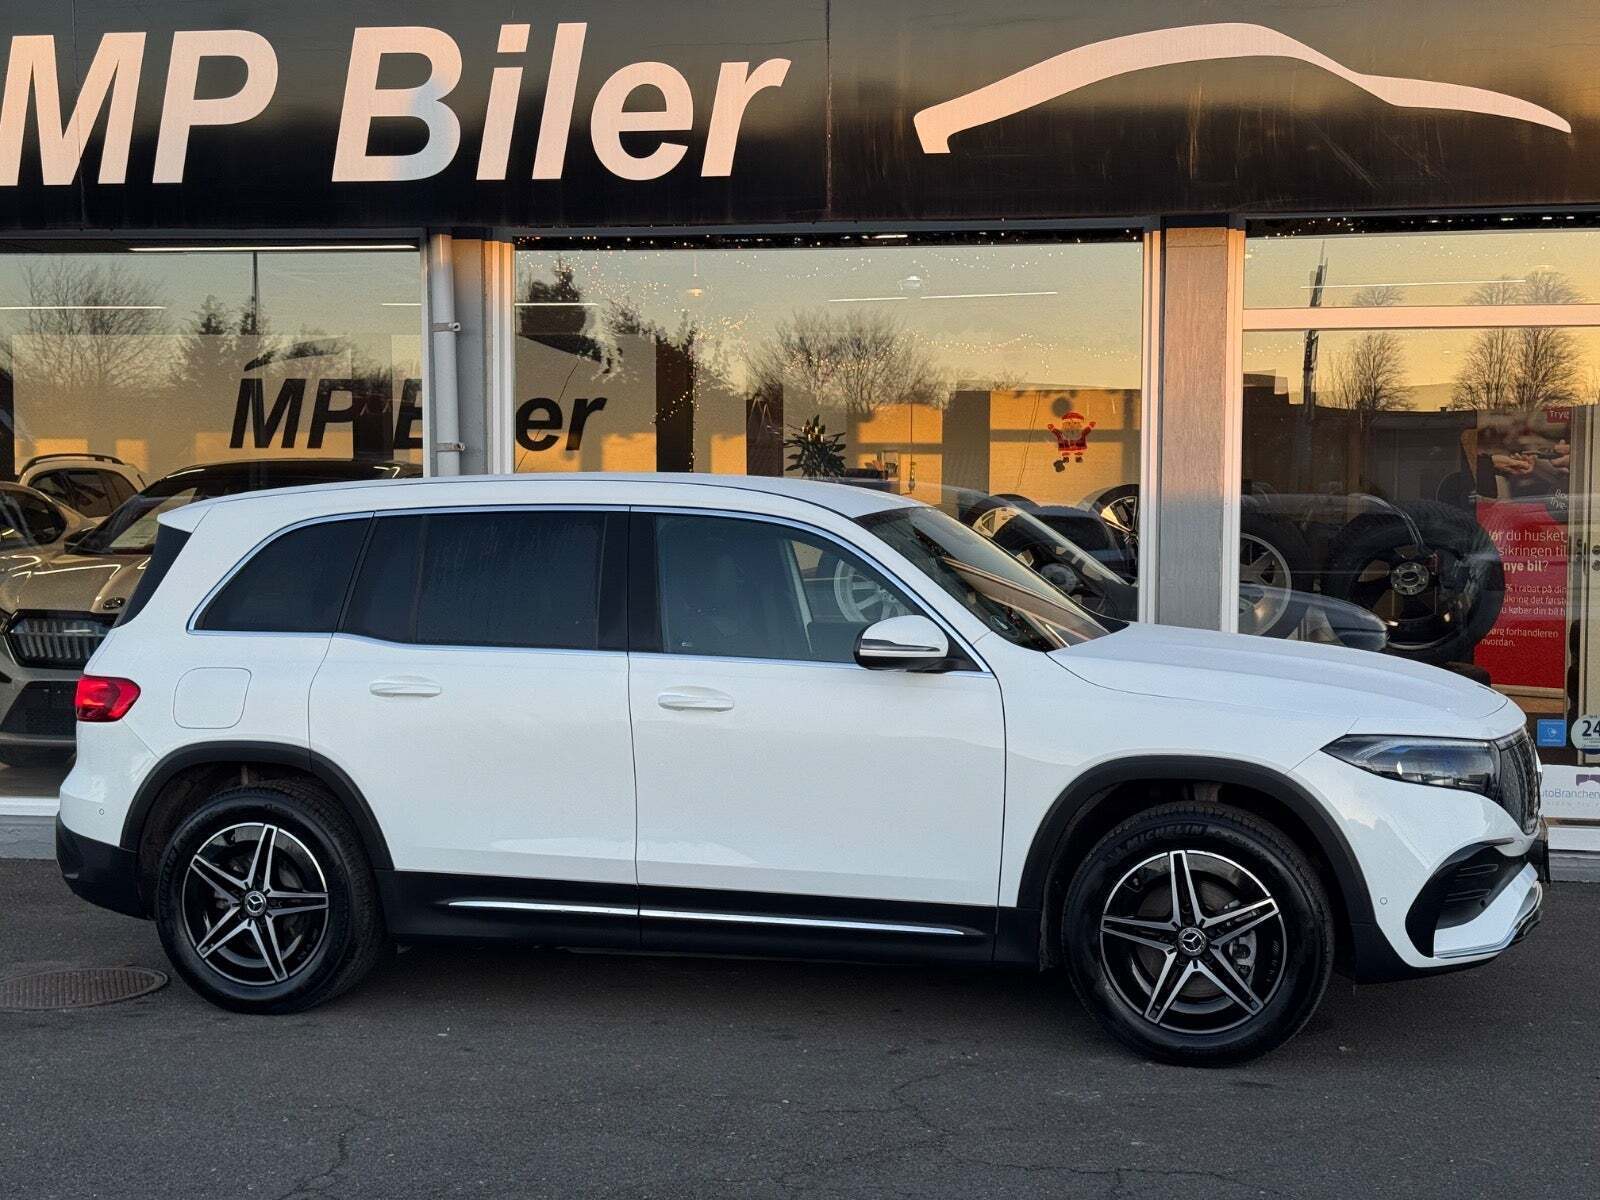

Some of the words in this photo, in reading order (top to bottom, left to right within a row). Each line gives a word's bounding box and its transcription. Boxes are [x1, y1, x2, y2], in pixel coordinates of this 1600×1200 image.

[0, 31, 278, 186] MP
[332, 22, 791, 182] Biler
[229, 378, 358, 450] MP
[1506, 529, 1521, 541] du
[1499, 544, 1553, 559] sikringen
[1503, 561, 1525, 574] nye
[1527, 560, 1549, 572] bil?
[1506, 627, 1559, 638] forhandleren
